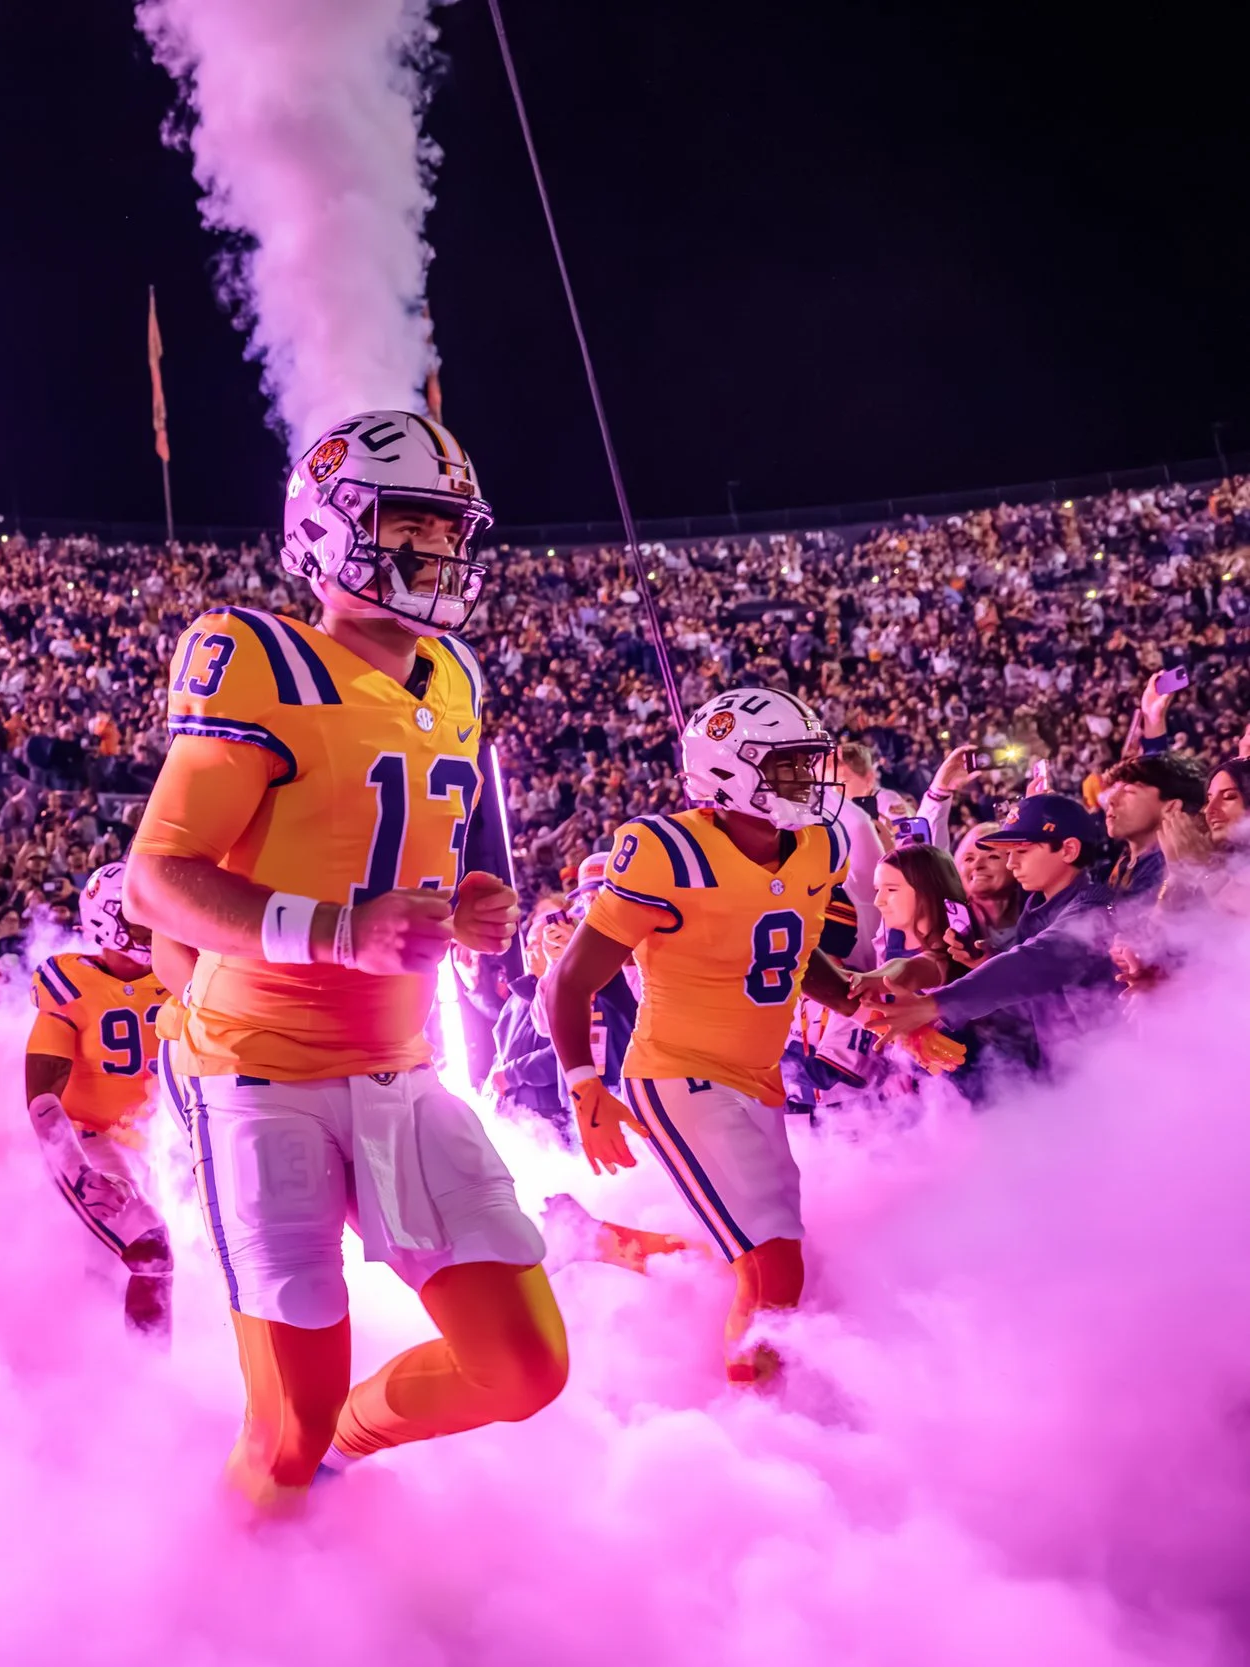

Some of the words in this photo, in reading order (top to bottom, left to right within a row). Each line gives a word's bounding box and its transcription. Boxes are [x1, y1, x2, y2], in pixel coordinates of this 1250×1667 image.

[173, 631, 238, 698] 13
[350, 751, 481, 912] 13
[613, 834, 639, 874] 8
[744, 908, 805, 1006] 8
